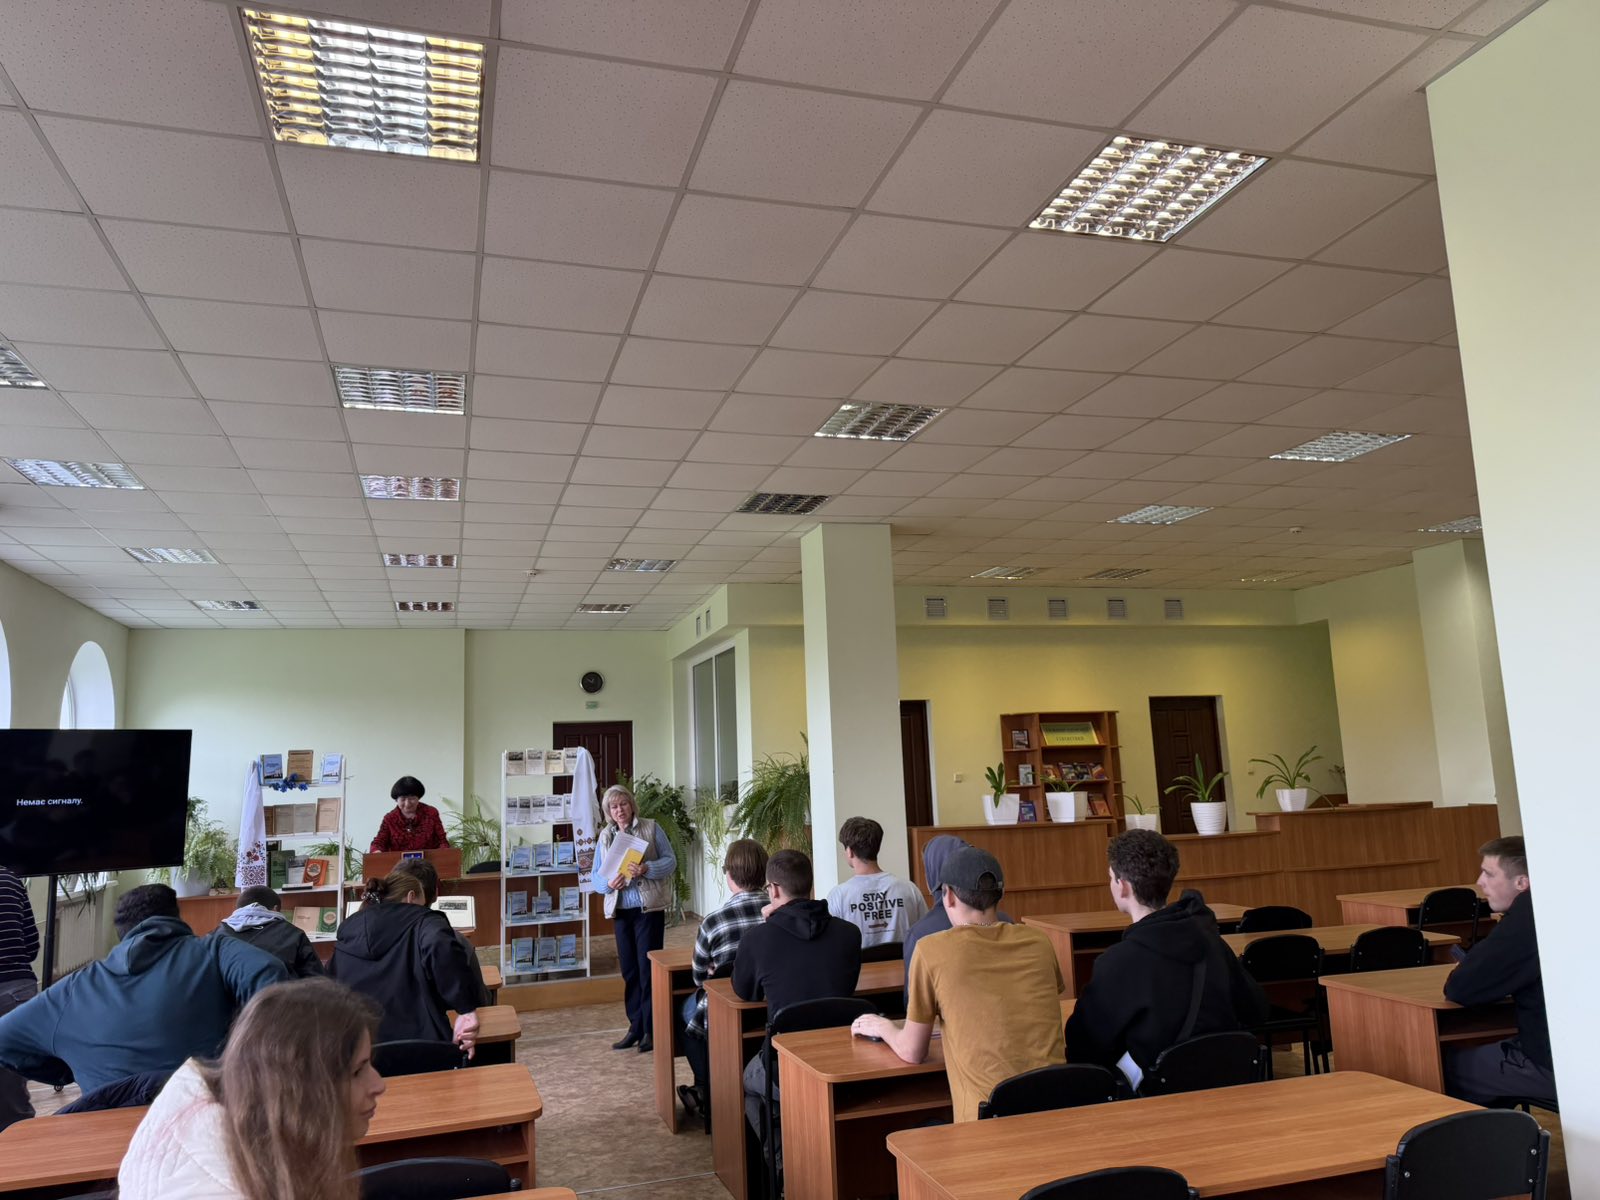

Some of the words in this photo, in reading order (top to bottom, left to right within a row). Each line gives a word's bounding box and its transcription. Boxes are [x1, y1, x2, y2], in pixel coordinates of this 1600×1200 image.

[47, 797, 83, 806] сигналу.
[863, 891, 888, 902] STAY
[850, 898, 904, 912] POSITIVE
[864, 909, 893, 921] FREE
